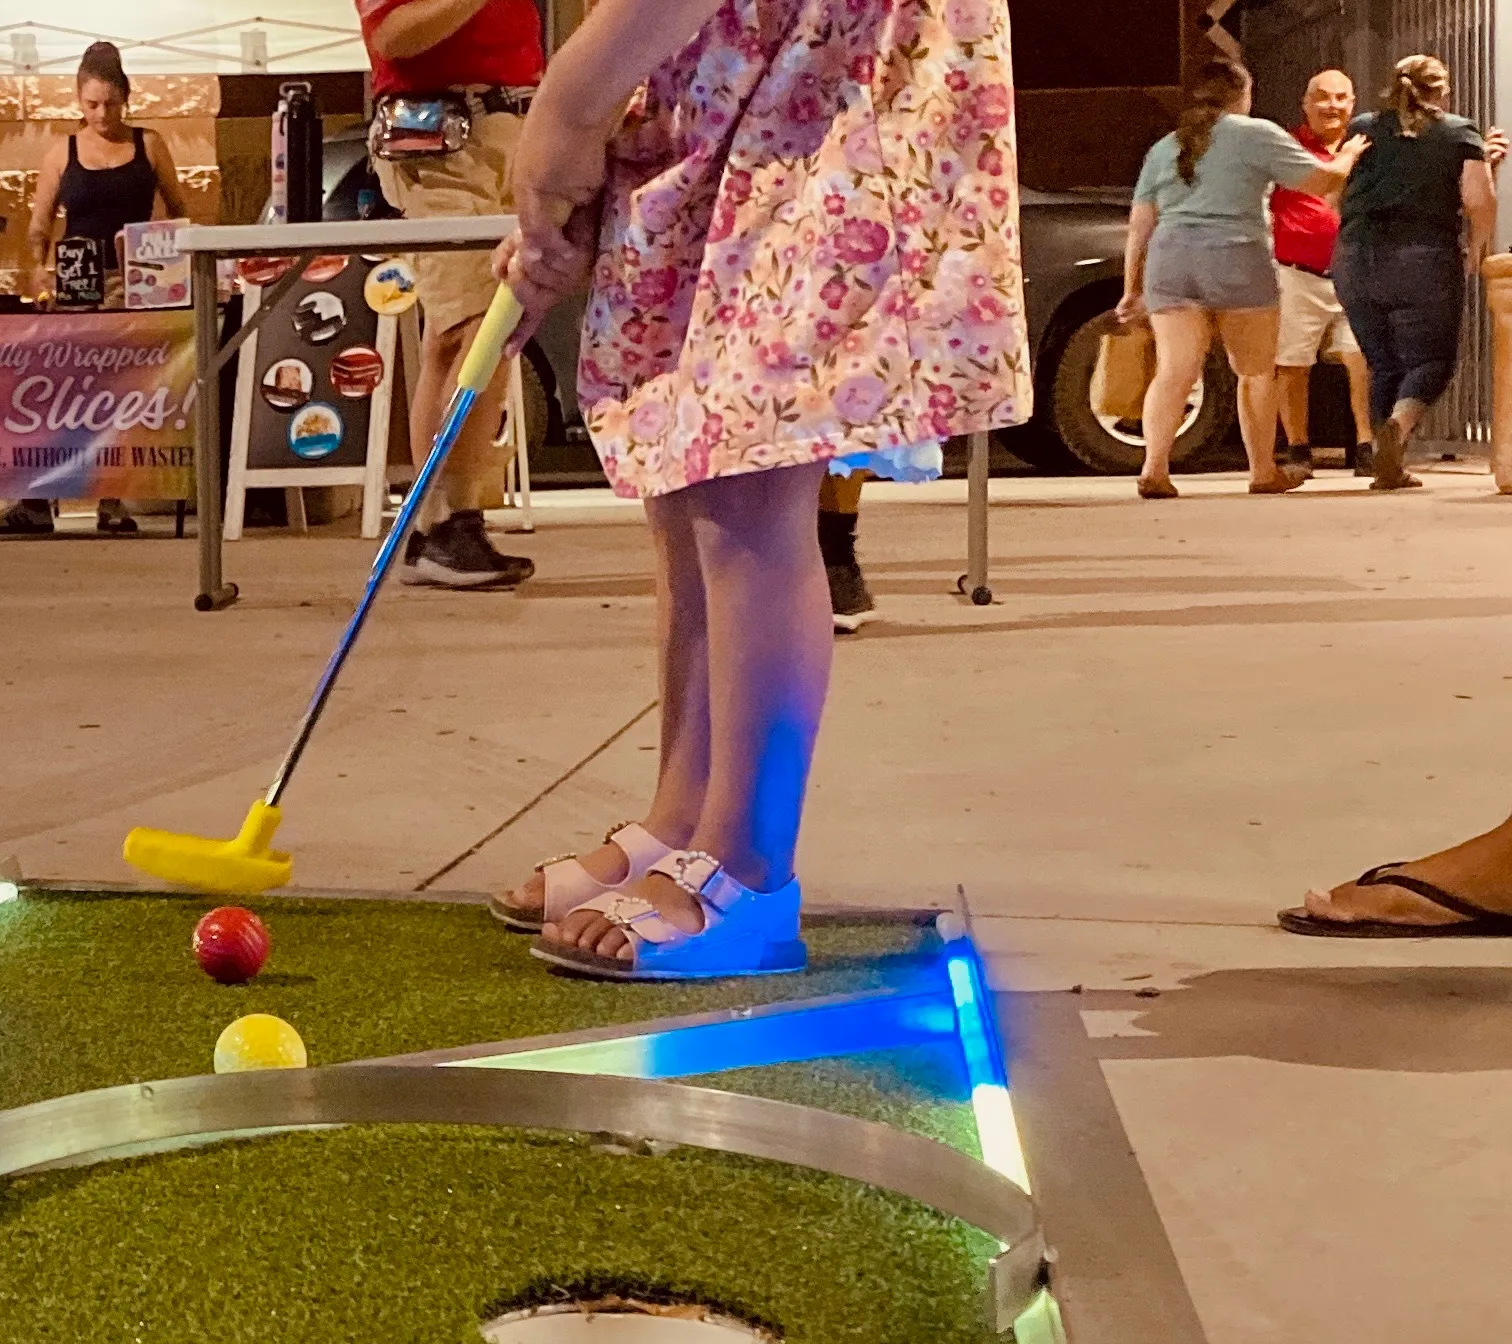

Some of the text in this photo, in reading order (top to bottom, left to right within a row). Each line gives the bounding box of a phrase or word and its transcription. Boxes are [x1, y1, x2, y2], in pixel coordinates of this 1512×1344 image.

[57, 244, 85, 262] Buy
[38, 341, 171, 373] Wrapped
[4, 375, 198, 434] Slices!
[12, 447, 86, 467] WITHOU
